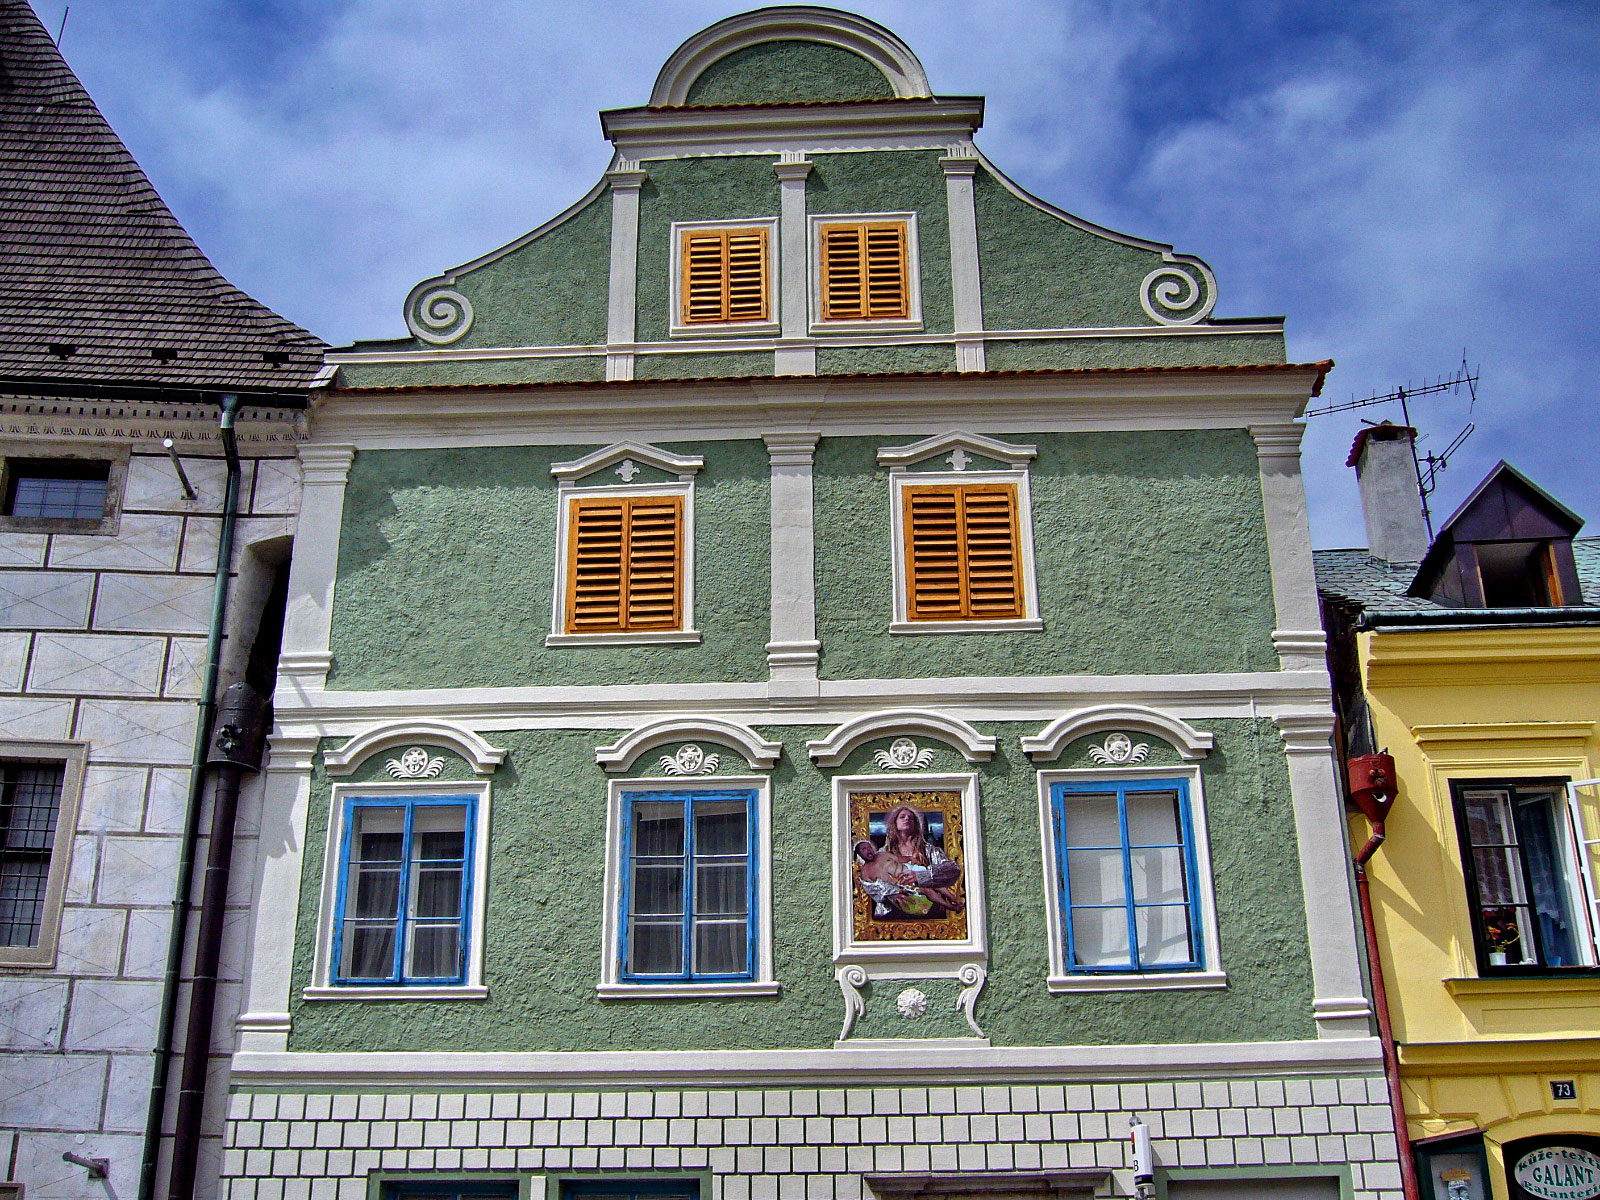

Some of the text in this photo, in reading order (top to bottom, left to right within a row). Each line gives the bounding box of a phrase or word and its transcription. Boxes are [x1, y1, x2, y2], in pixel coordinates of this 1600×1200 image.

[1556, 1084, 1571, 1096] 73
[1533, 1164, 1594, 1187] GALANT
[1524, 1180, 1600, 1199] galanteri
